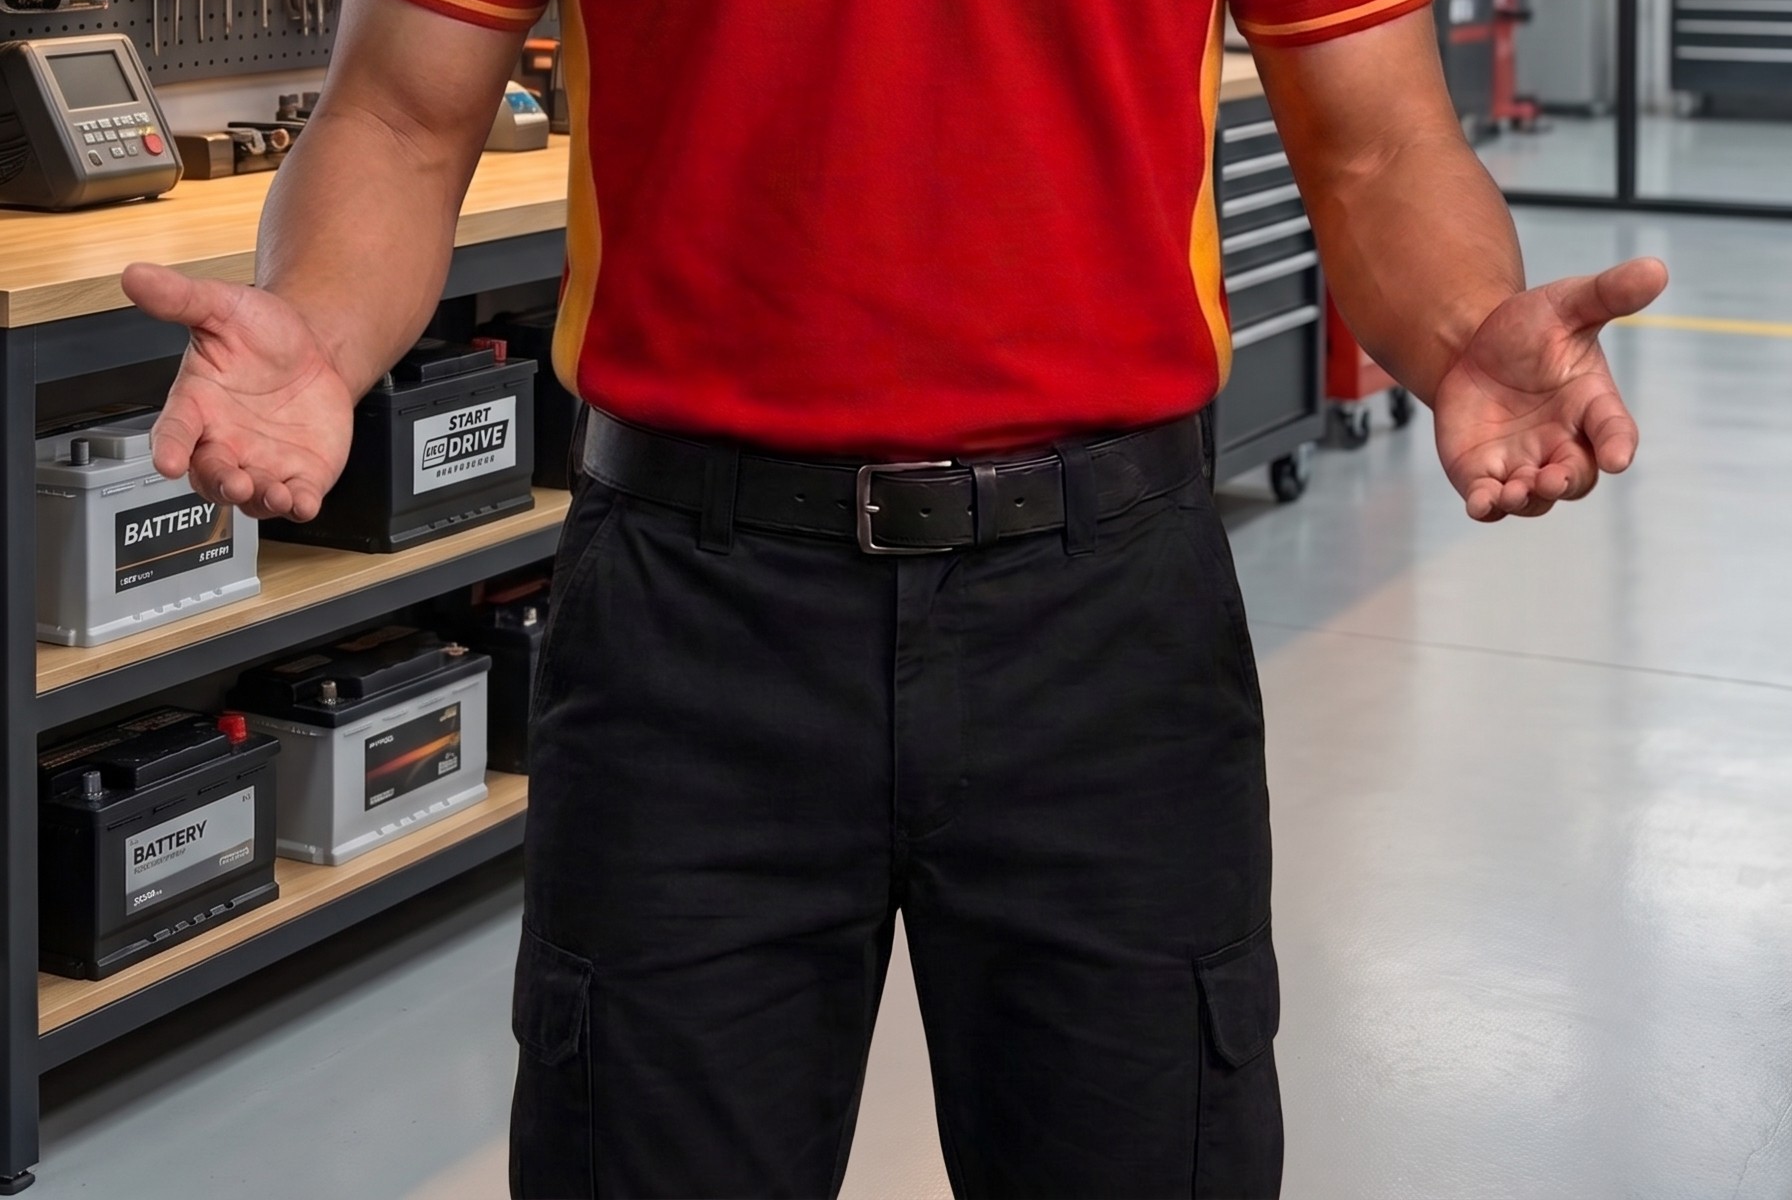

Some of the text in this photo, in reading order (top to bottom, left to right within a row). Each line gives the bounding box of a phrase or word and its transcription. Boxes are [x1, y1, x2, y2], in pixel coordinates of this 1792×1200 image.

[448, 407, 492, 431] START
[448, 424, 504, 458] DRIVE
[124, 502, 216, 547] BATTERY
[133, 819, 208, 866] BATTERY
